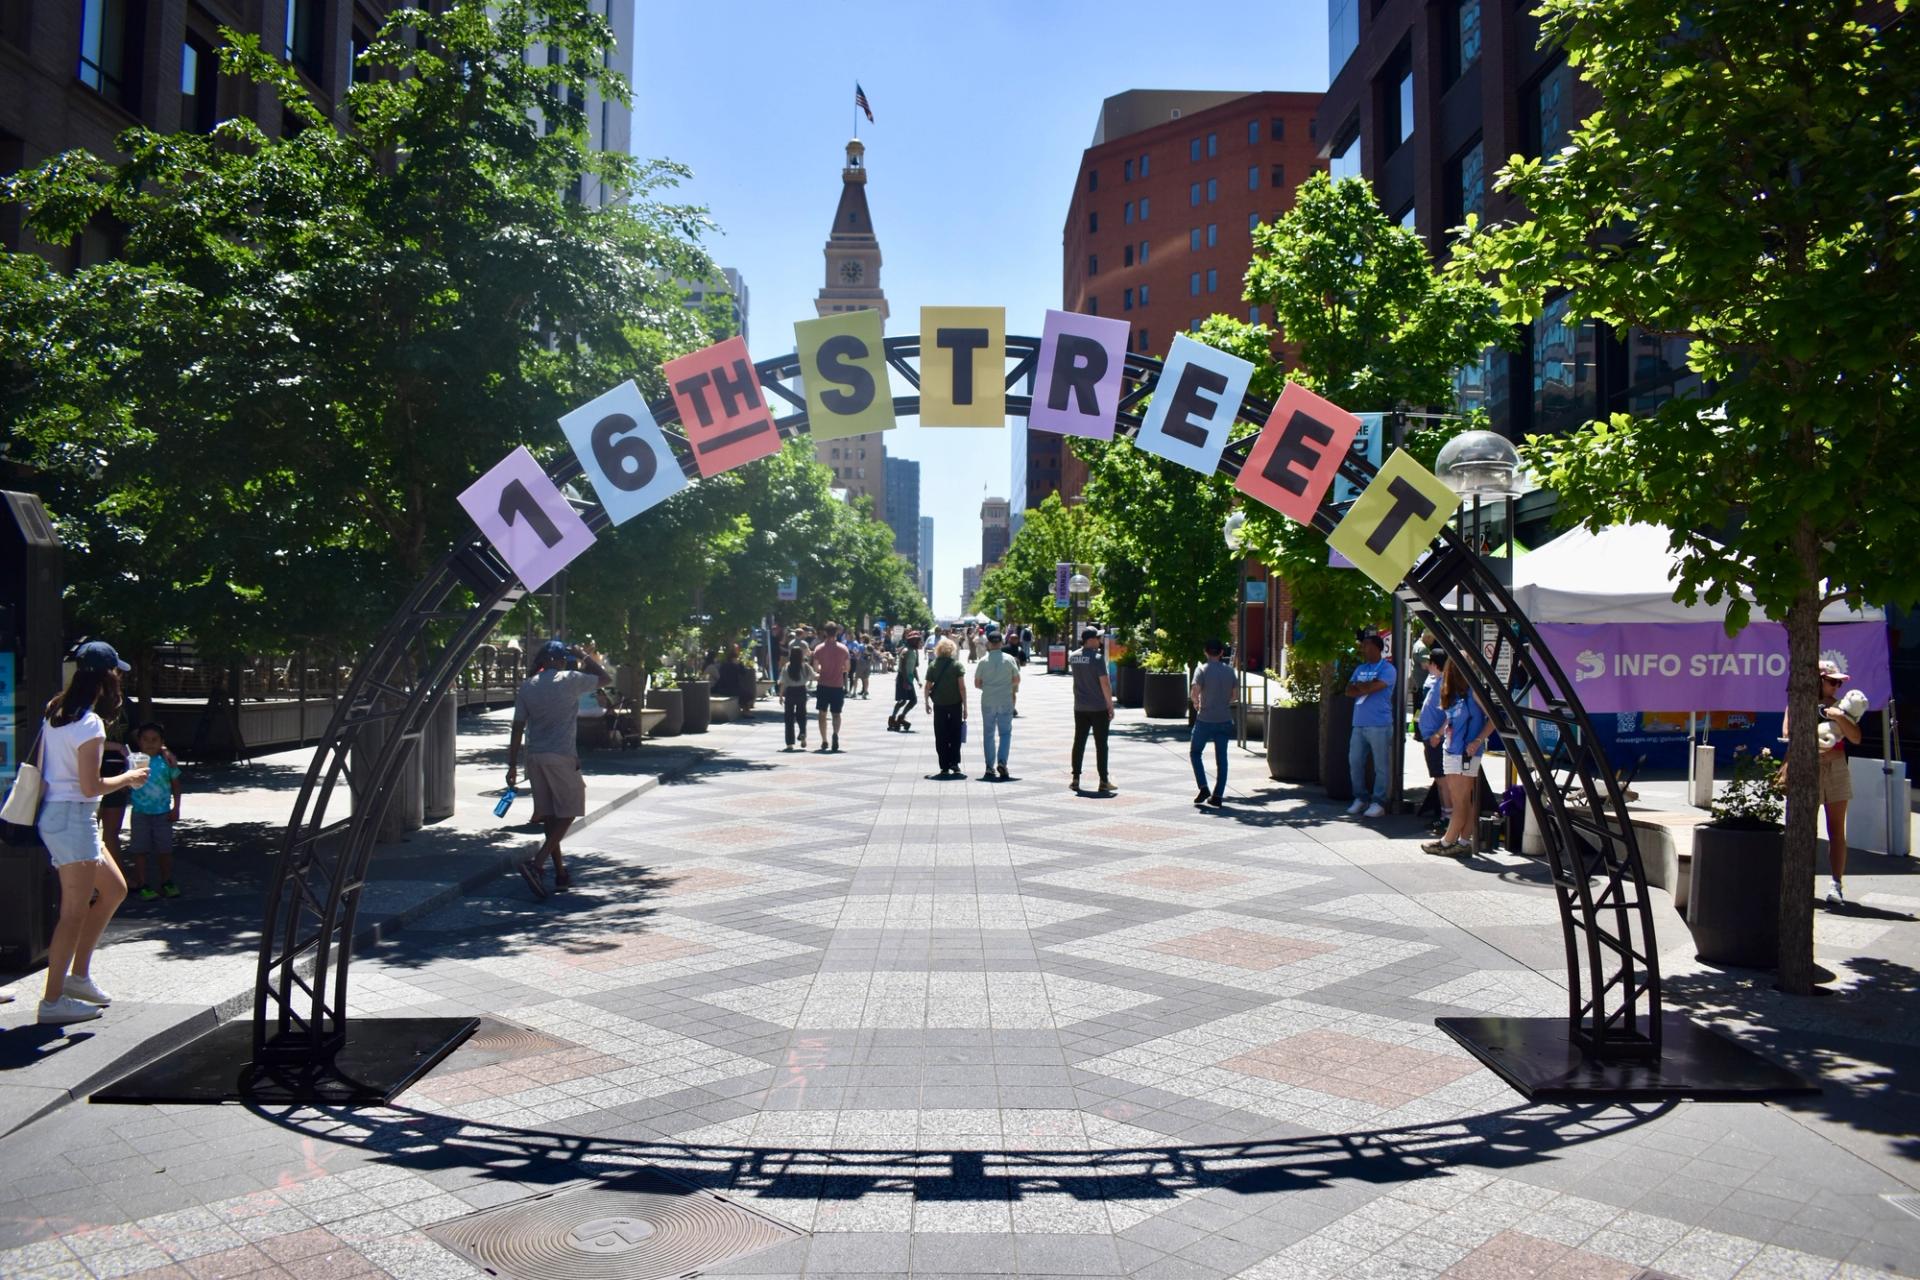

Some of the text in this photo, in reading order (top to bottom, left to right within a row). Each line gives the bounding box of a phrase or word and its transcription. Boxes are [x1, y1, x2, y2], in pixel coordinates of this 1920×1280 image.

[498, 327, 1436, 555] 16TH STREET
[1355, 425, 1369, 435] HE
[1614, 653, 1787, 677] INFO STATIO
